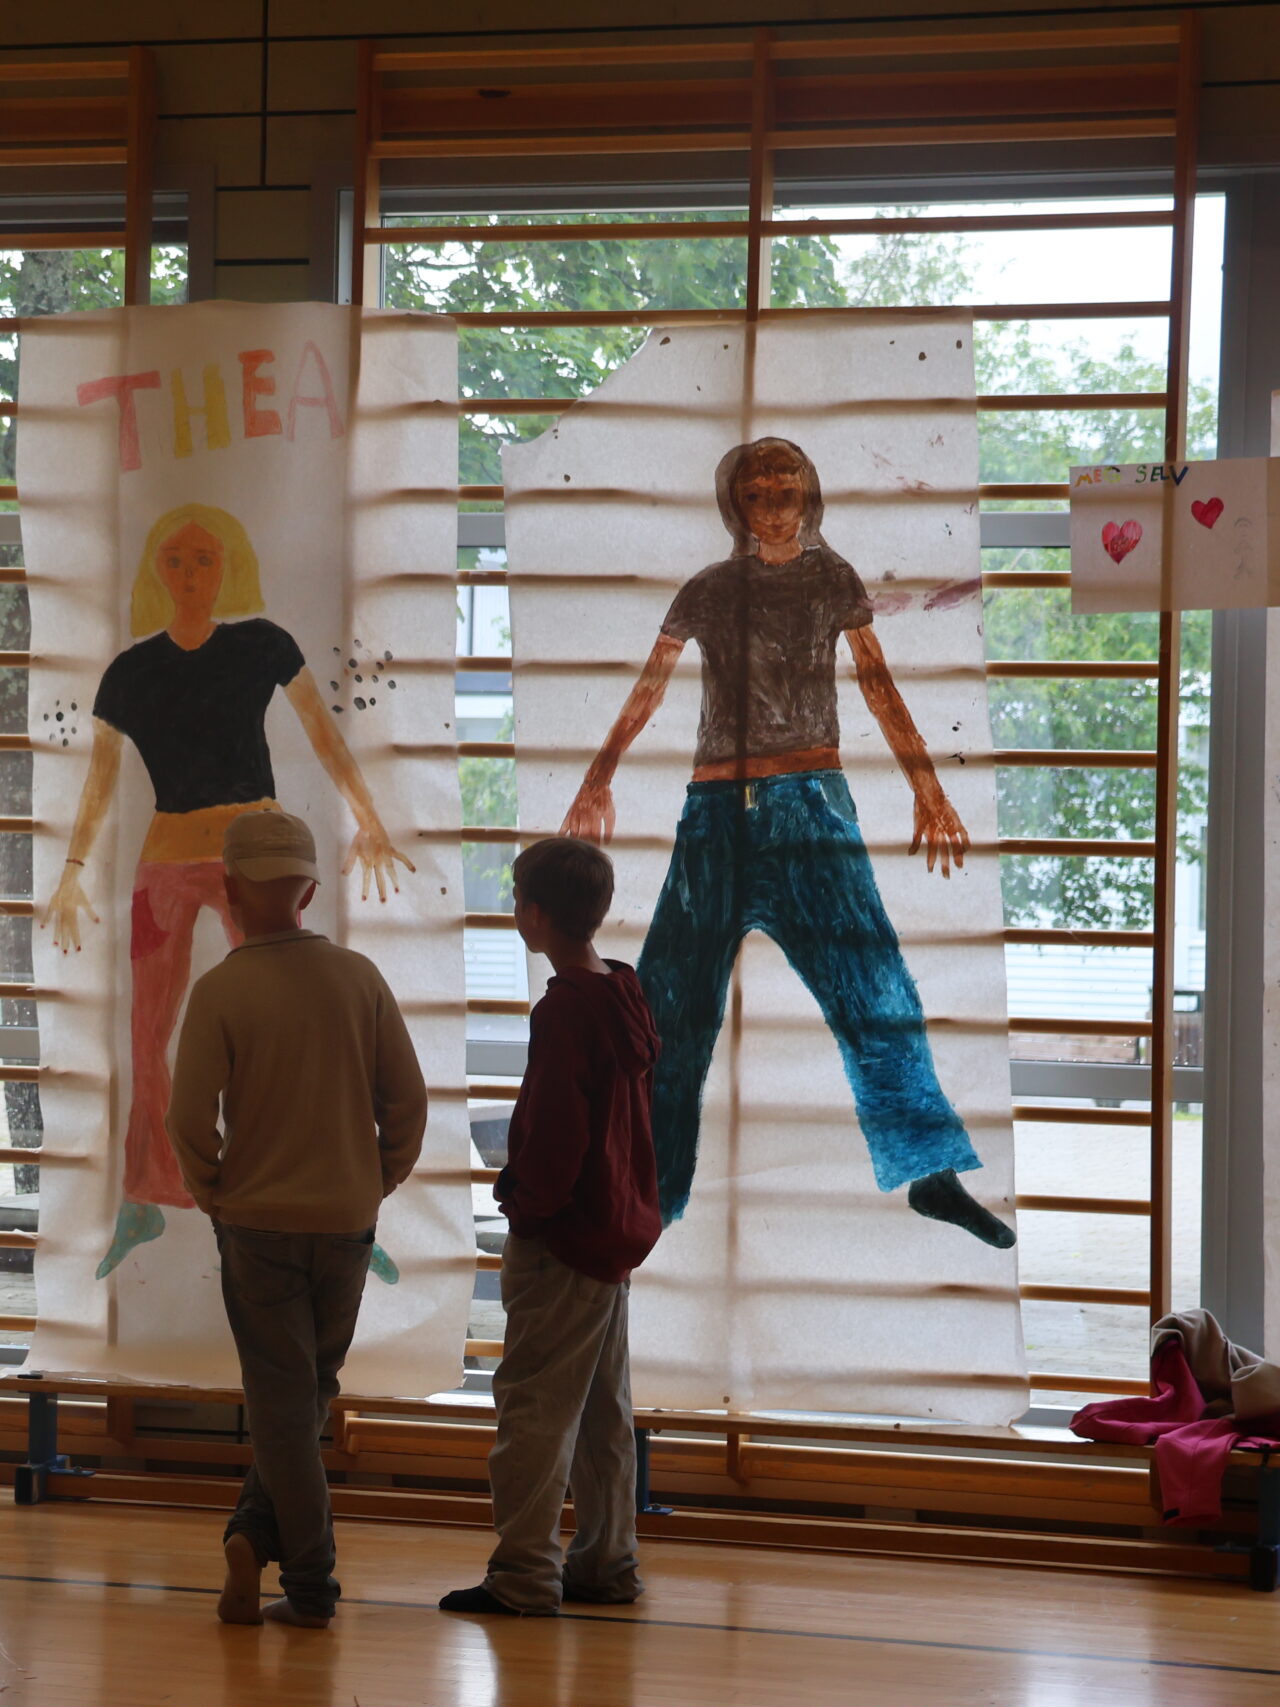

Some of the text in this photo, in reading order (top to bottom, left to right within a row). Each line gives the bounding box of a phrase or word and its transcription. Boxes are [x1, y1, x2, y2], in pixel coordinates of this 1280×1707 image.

[76, 340, 345, 472] THEA
[1075, 464, 1189, 487] MEG SELV
